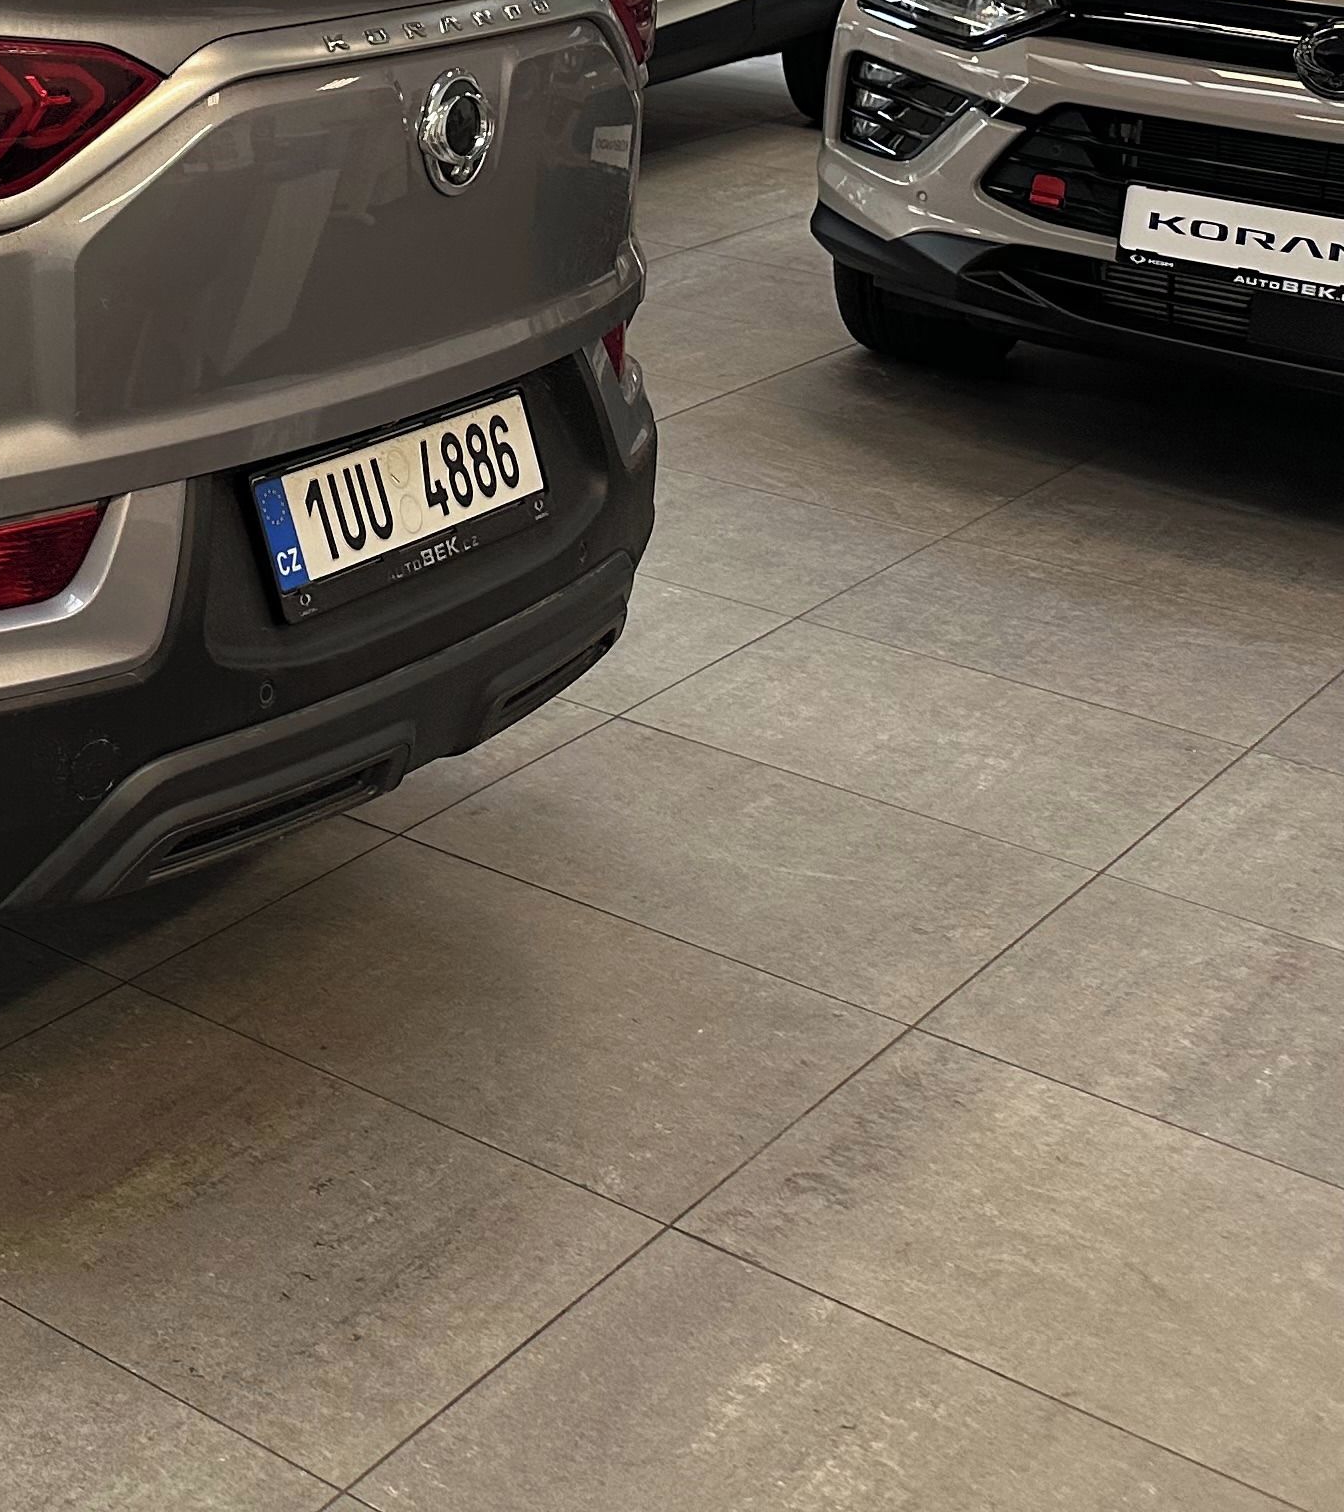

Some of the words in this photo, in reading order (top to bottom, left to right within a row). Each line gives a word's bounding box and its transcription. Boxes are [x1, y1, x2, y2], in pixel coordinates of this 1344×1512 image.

[322, 0, 551, 52] KORANDO
[1233, 275, 1344, 301] AUTOBEK.
[305, 457, 394, 560] 1UU
[419, 414, 520, 516] 4886
[276, 547, 302, 576] CZ
